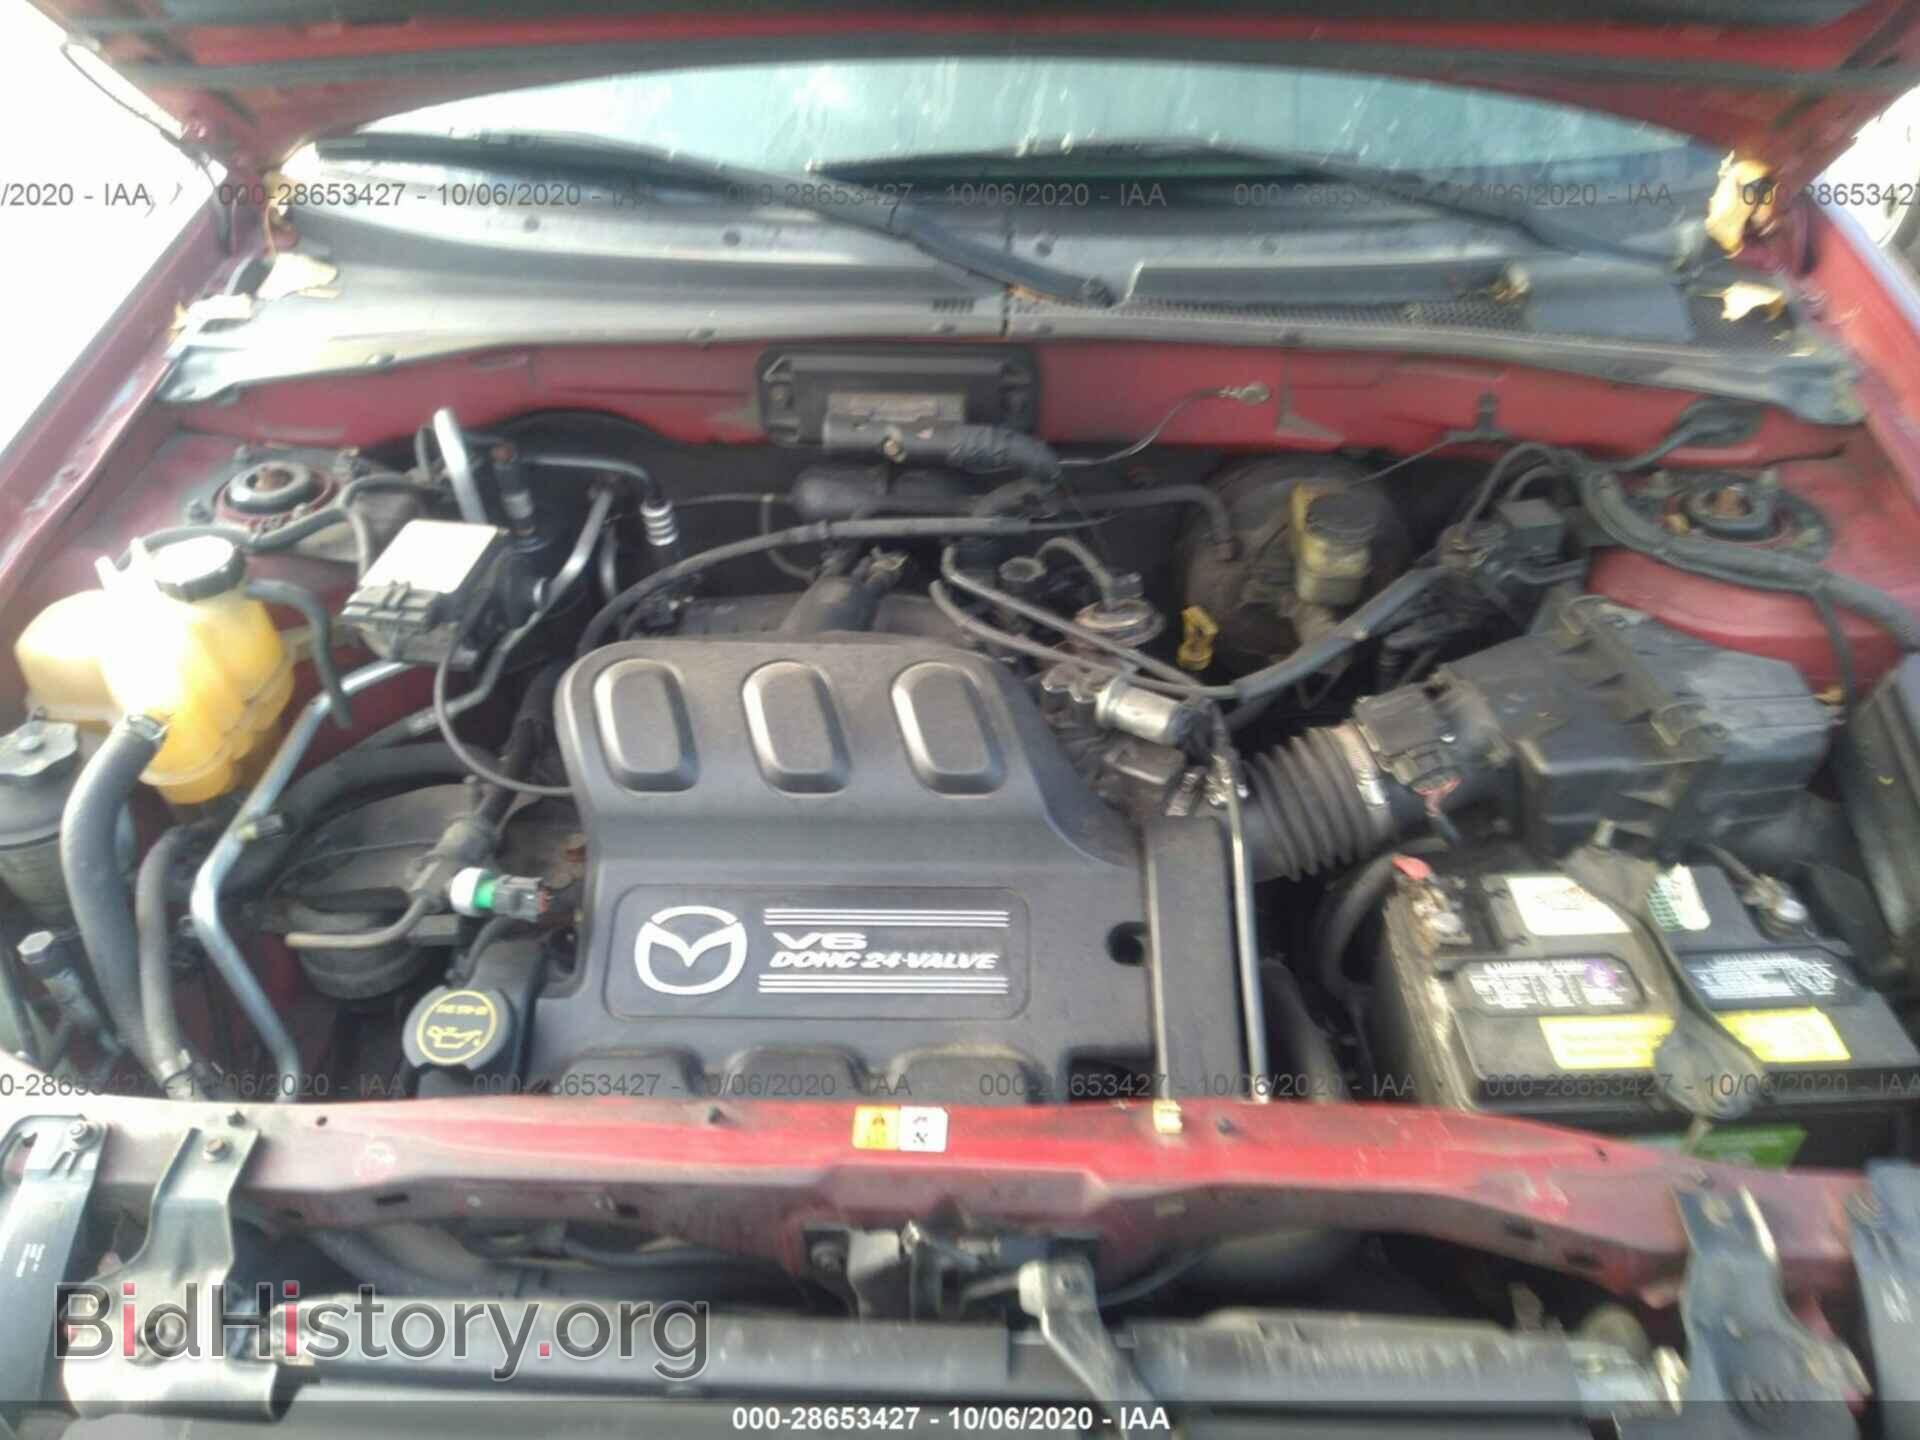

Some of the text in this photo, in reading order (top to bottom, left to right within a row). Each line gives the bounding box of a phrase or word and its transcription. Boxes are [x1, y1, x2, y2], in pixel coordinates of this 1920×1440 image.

[773, 932, 868, 950] V6
[769, 951, 1000, 970] DOHC 24-VALVE
